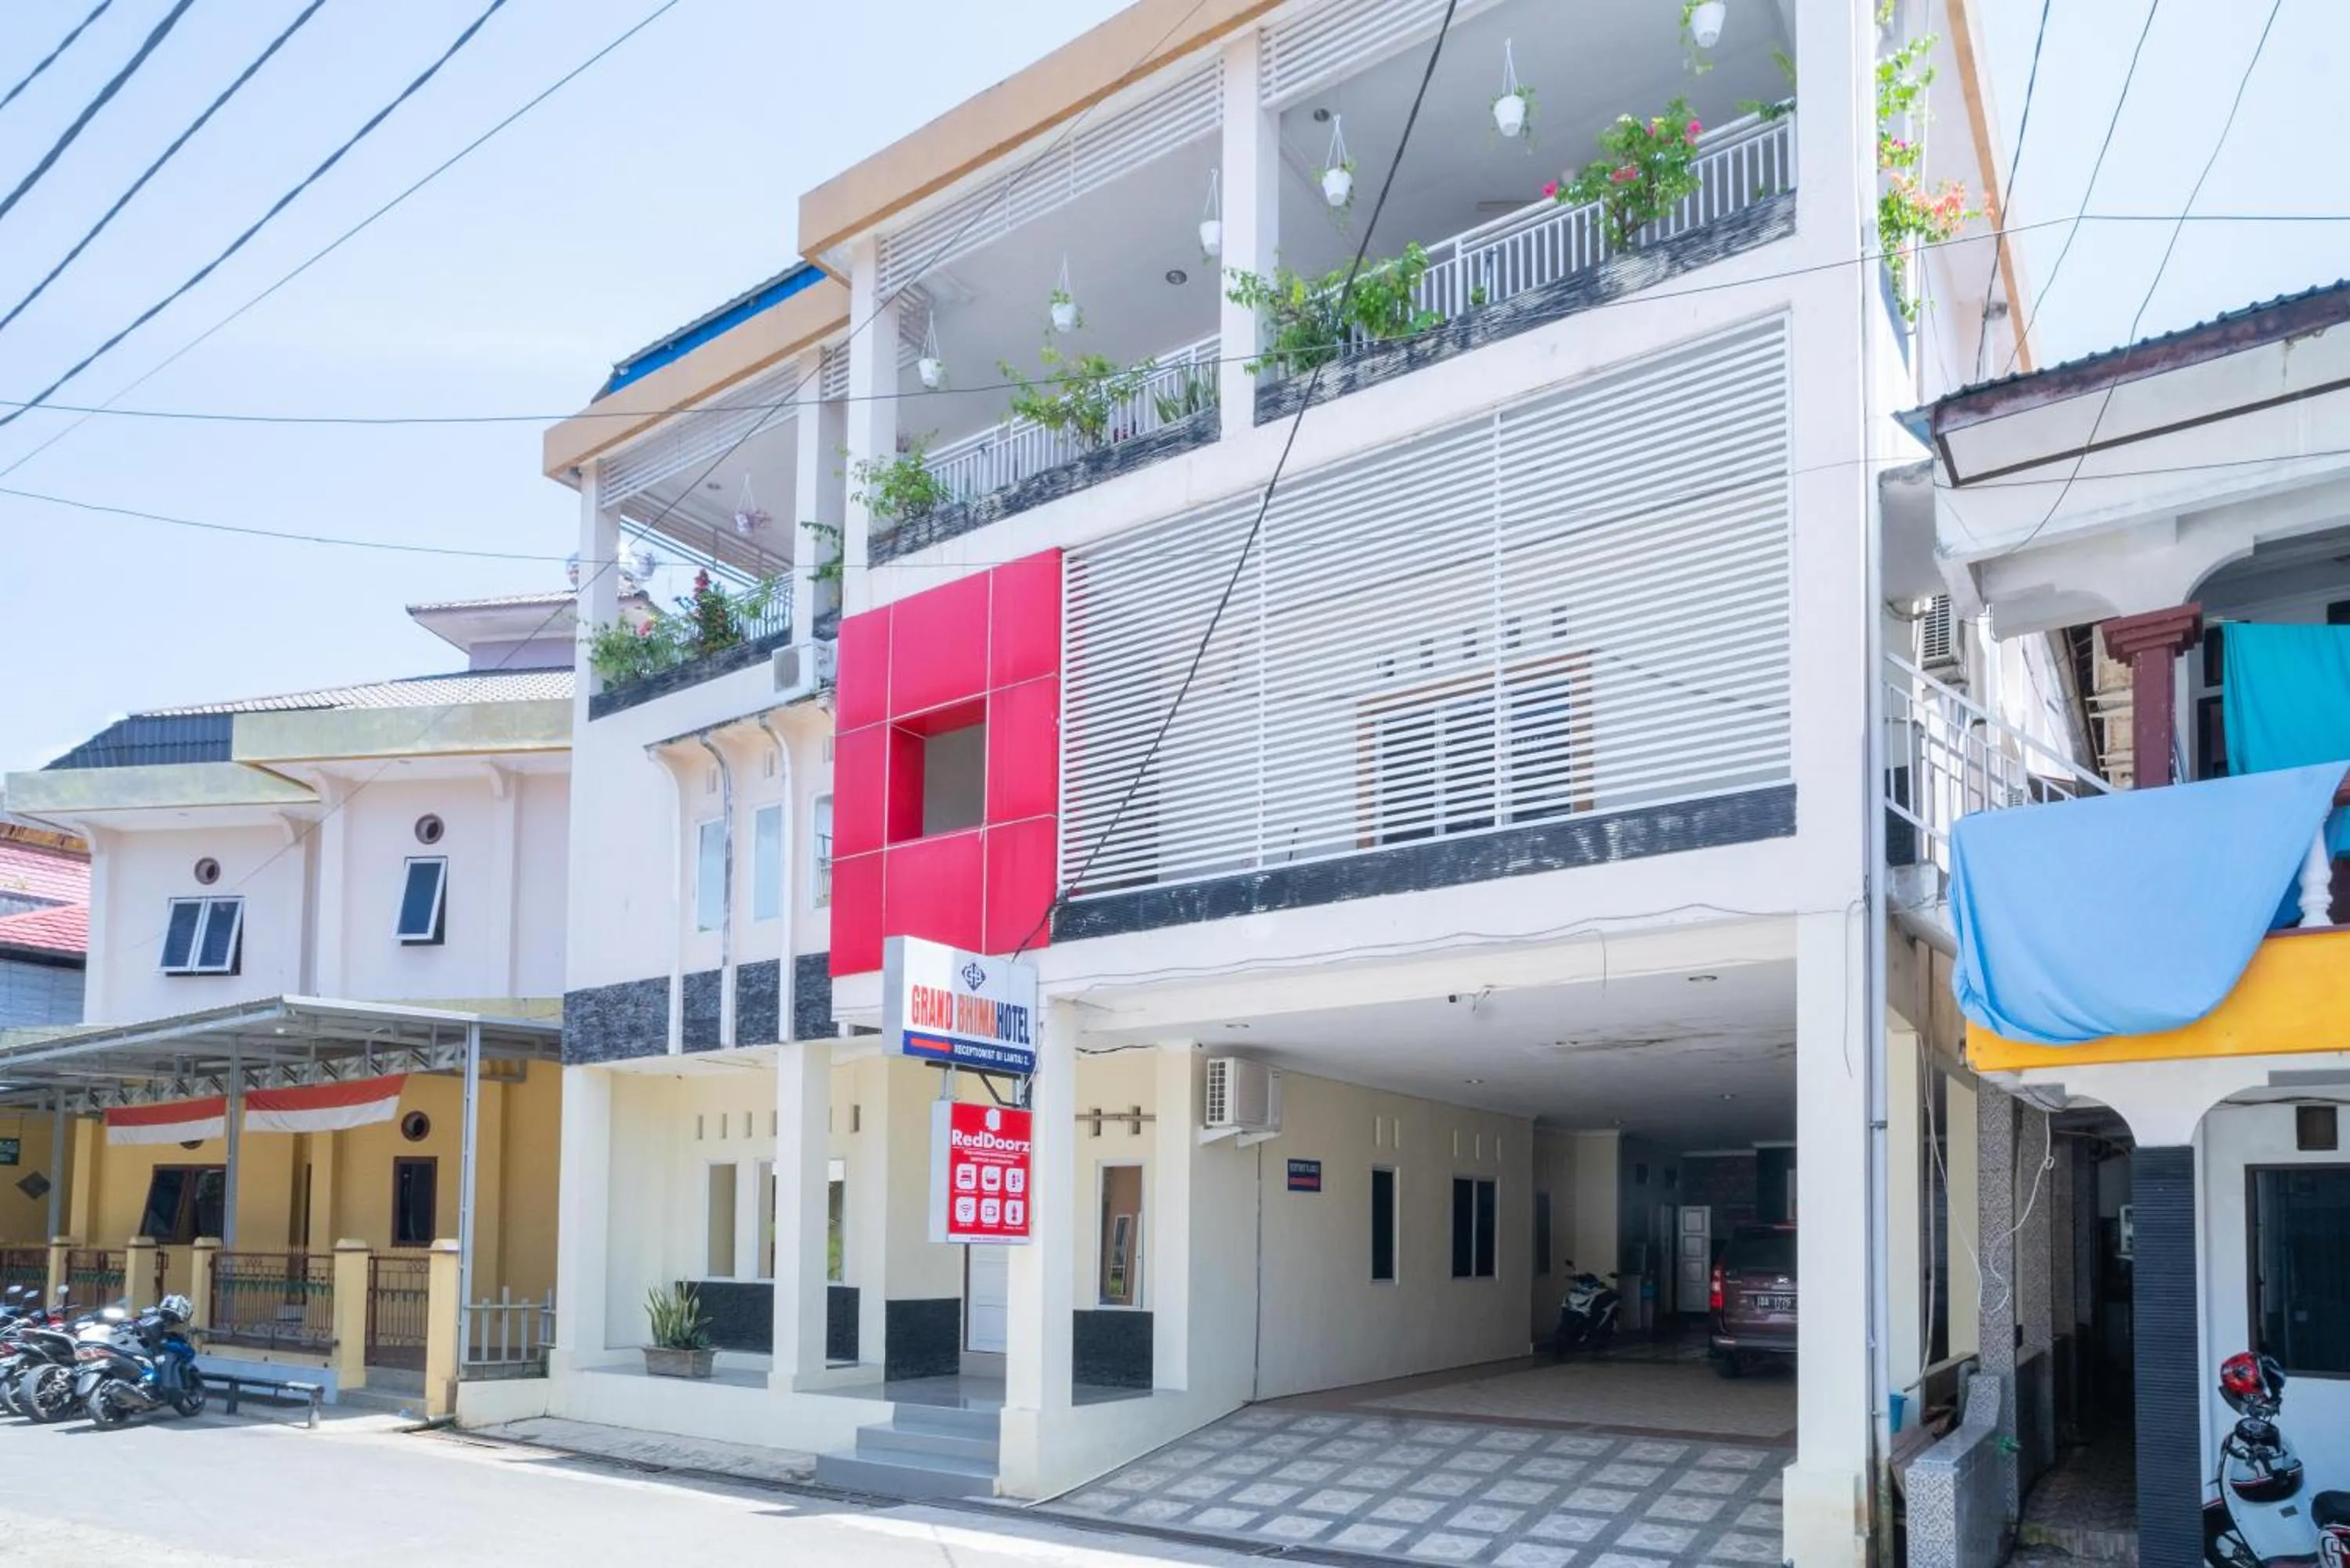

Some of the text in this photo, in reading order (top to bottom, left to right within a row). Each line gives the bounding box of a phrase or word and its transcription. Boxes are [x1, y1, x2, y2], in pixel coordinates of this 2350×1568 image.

[912, 985, 1030, 1044] GRAND BHIMA HOTEL
[952, 1129, 1030, 1152] RedDoorz
